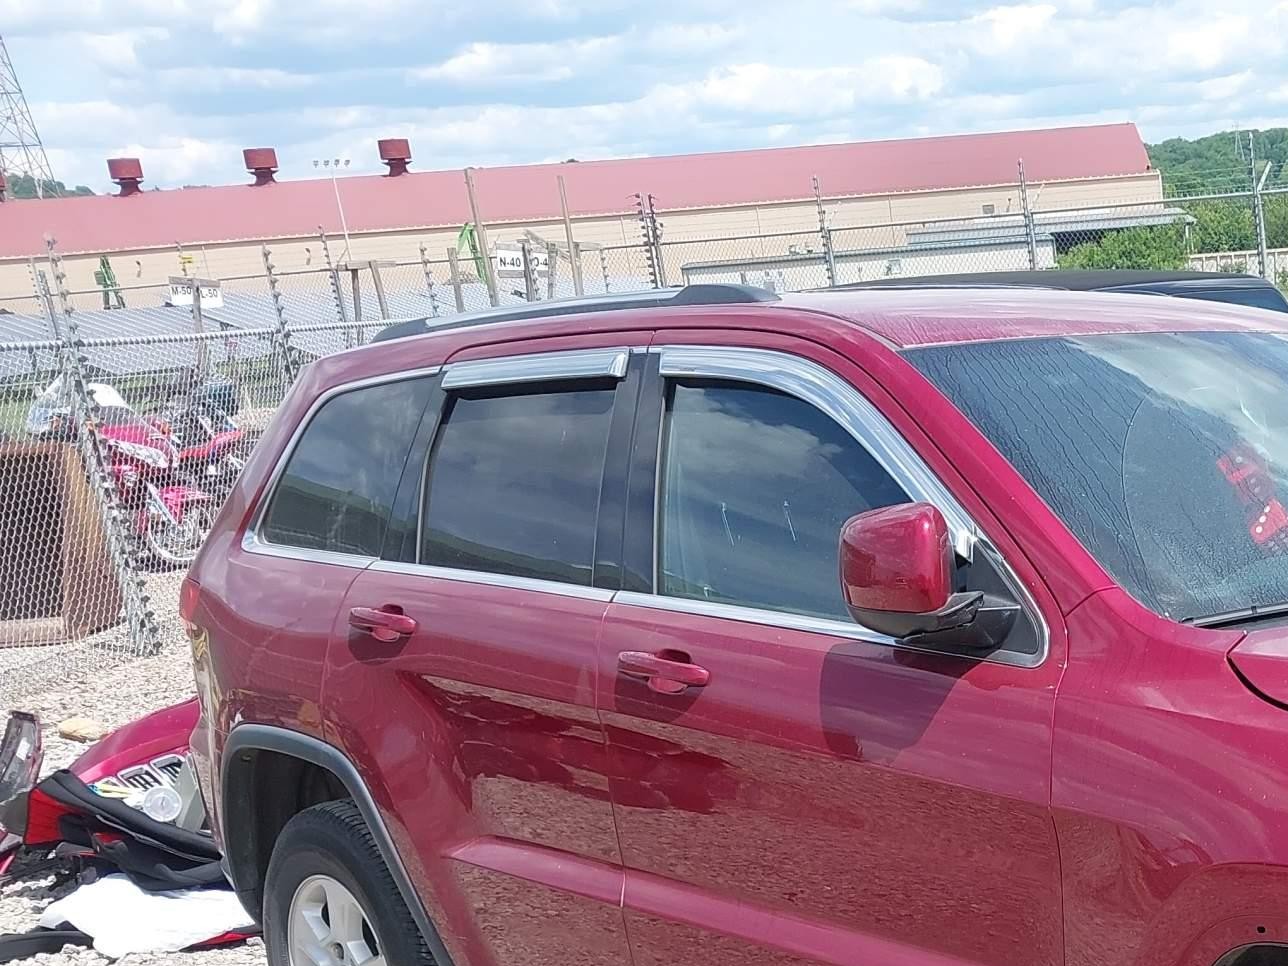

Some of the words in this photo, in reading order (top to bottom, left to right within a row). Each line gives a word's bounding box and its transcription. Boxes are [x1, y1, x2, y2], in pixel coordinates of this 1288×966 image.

[499, 257, 521, 267] N-40
[171, 286, 192, 295] M-50
[200, 288, 218, 298] L-50
